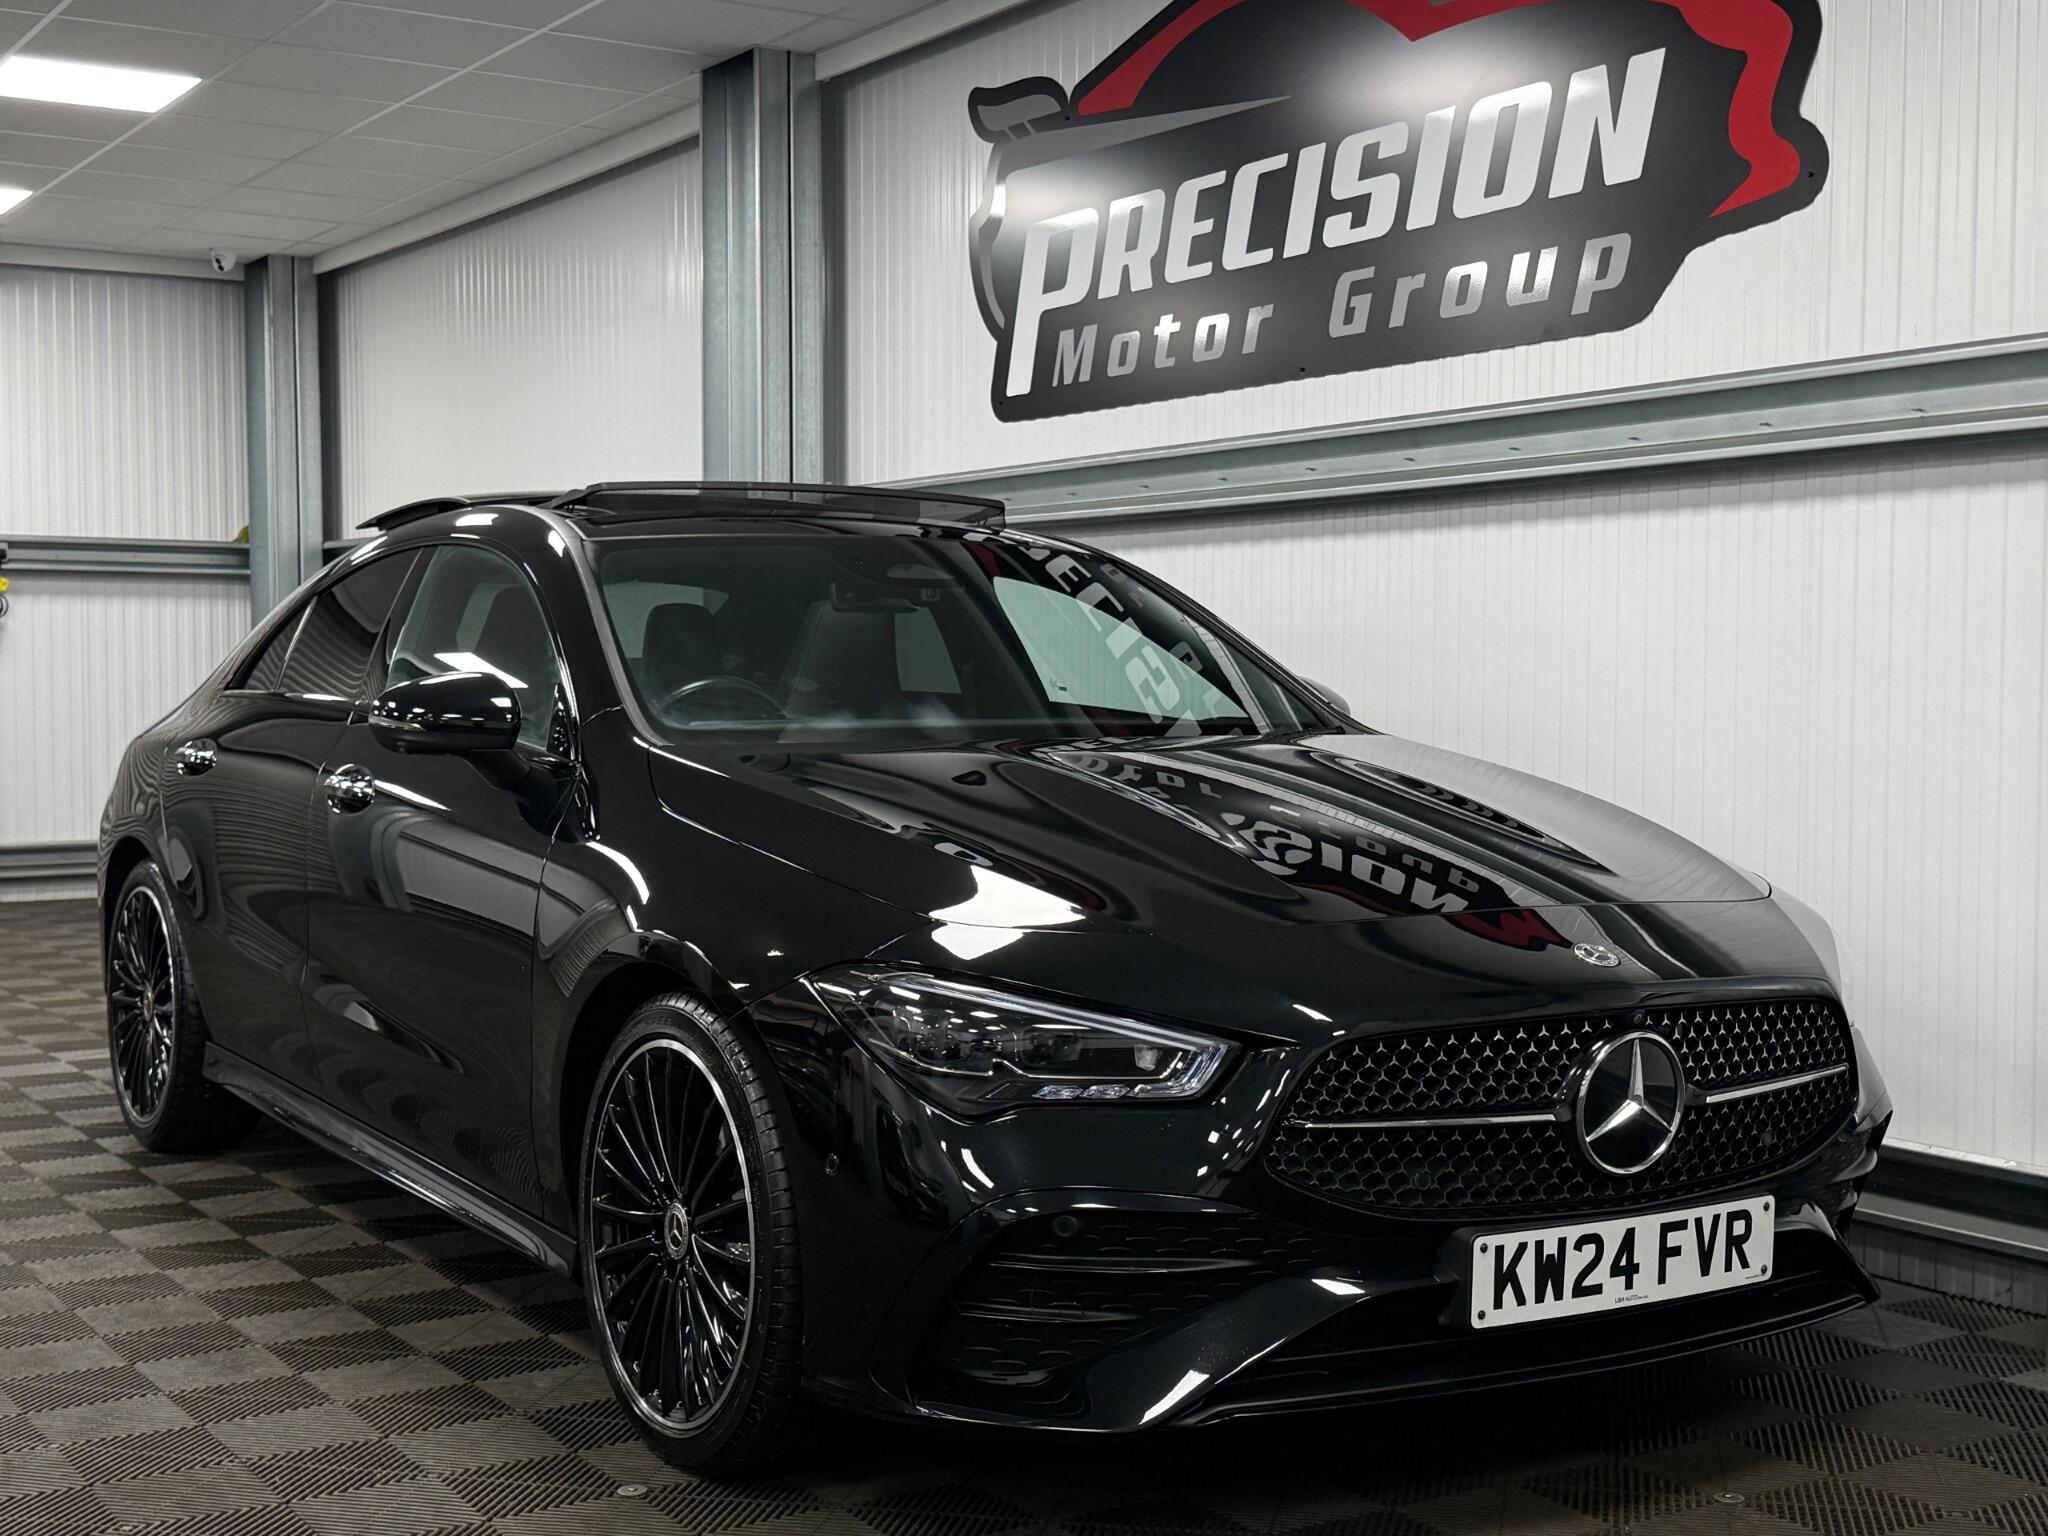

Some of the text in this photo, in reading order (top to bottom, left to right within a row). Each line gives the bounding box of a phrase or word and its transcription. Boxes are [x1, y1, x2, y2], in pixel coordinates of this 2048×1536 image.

[1006, 47, 1667, 397] PRECISION
[1053, 232, 1632, 387] Motor Group
[1493, 1209, 1753, 1311] KW24 FVR
